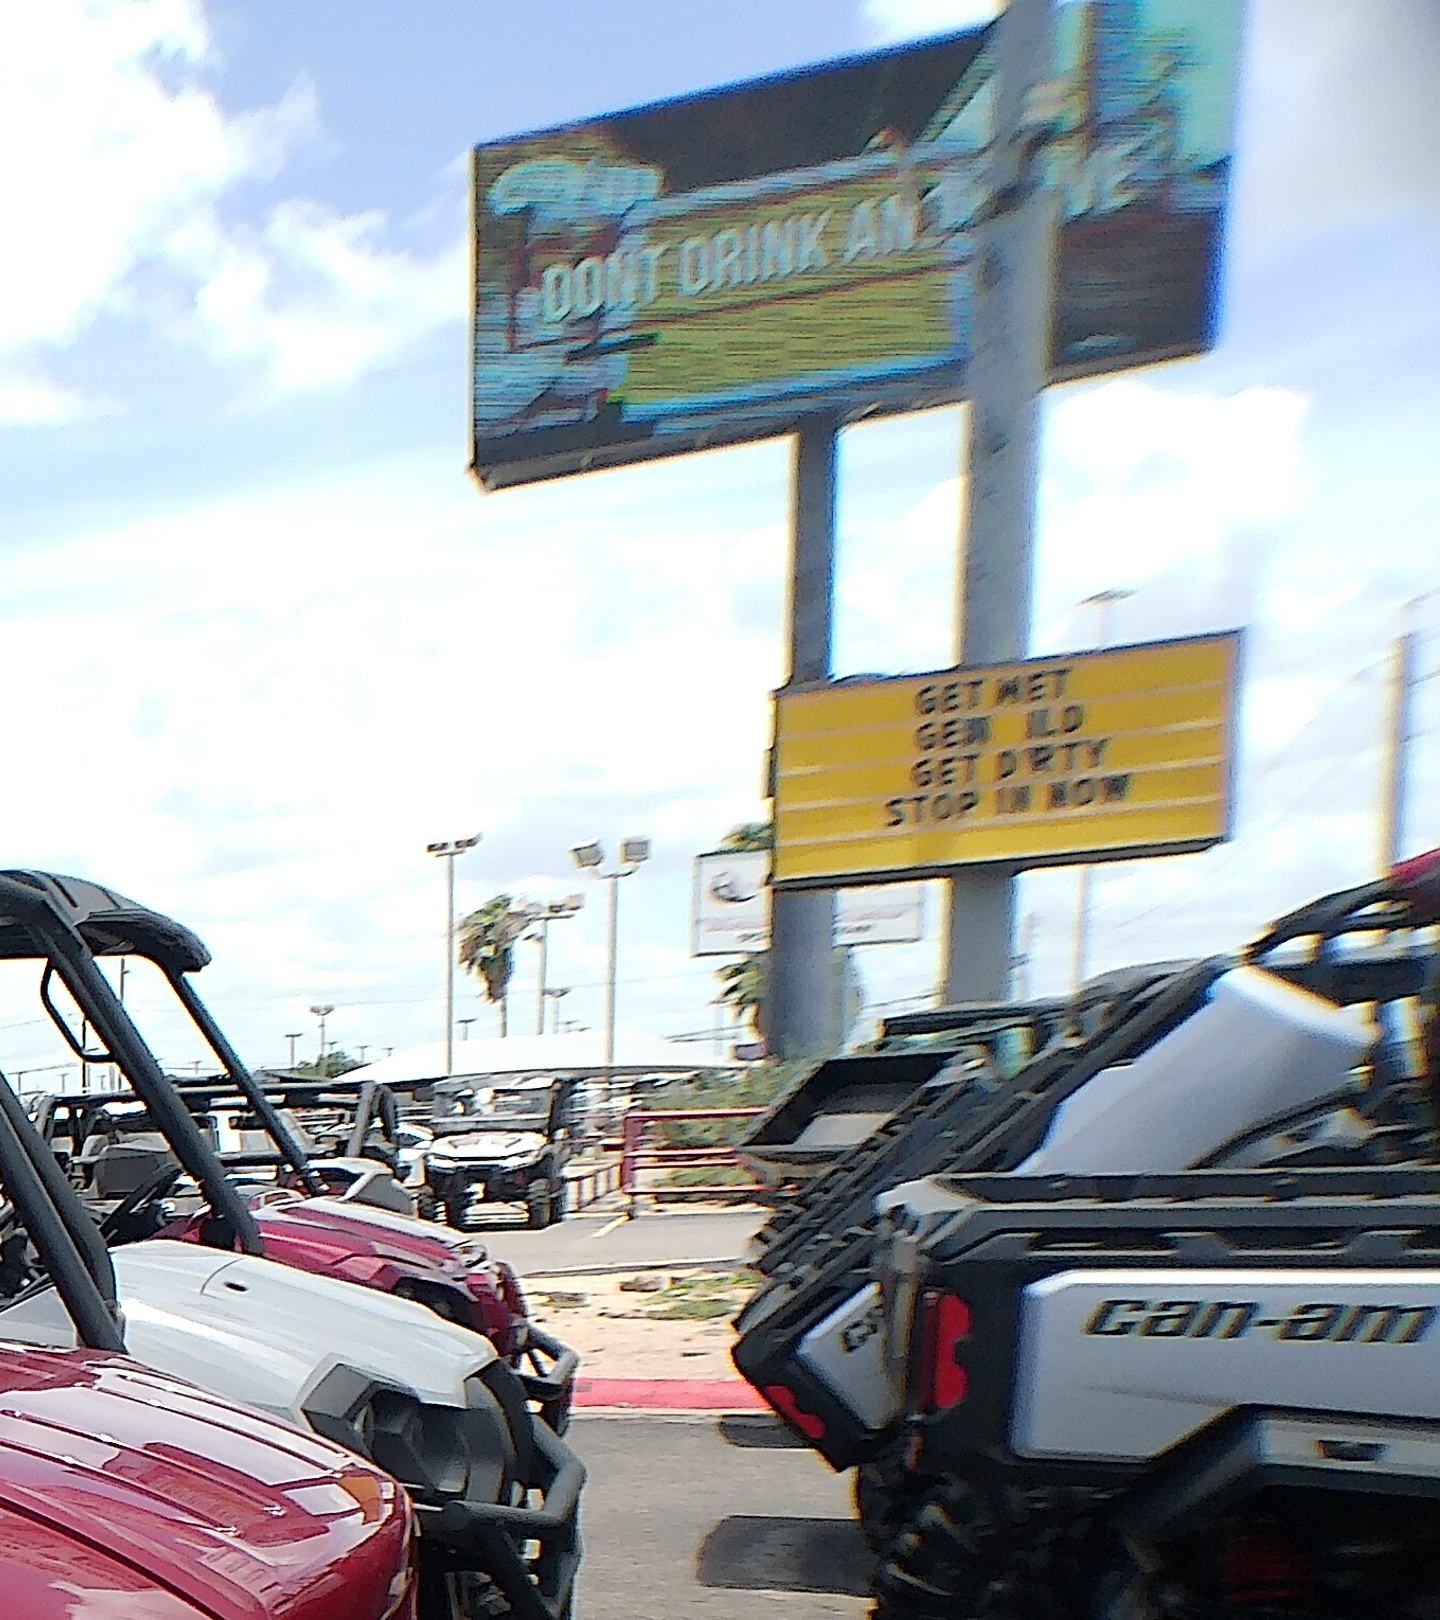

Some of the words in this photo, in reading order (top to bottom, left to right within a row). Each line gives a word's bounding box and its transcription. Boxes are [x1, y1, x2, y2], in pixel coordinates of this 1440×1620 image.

[677, 212, 833, 298] DRINK
[915, 679, 984, 715] GET
[911, 753, 981, 787] GET
[885, 791, 979, 827] STOP
